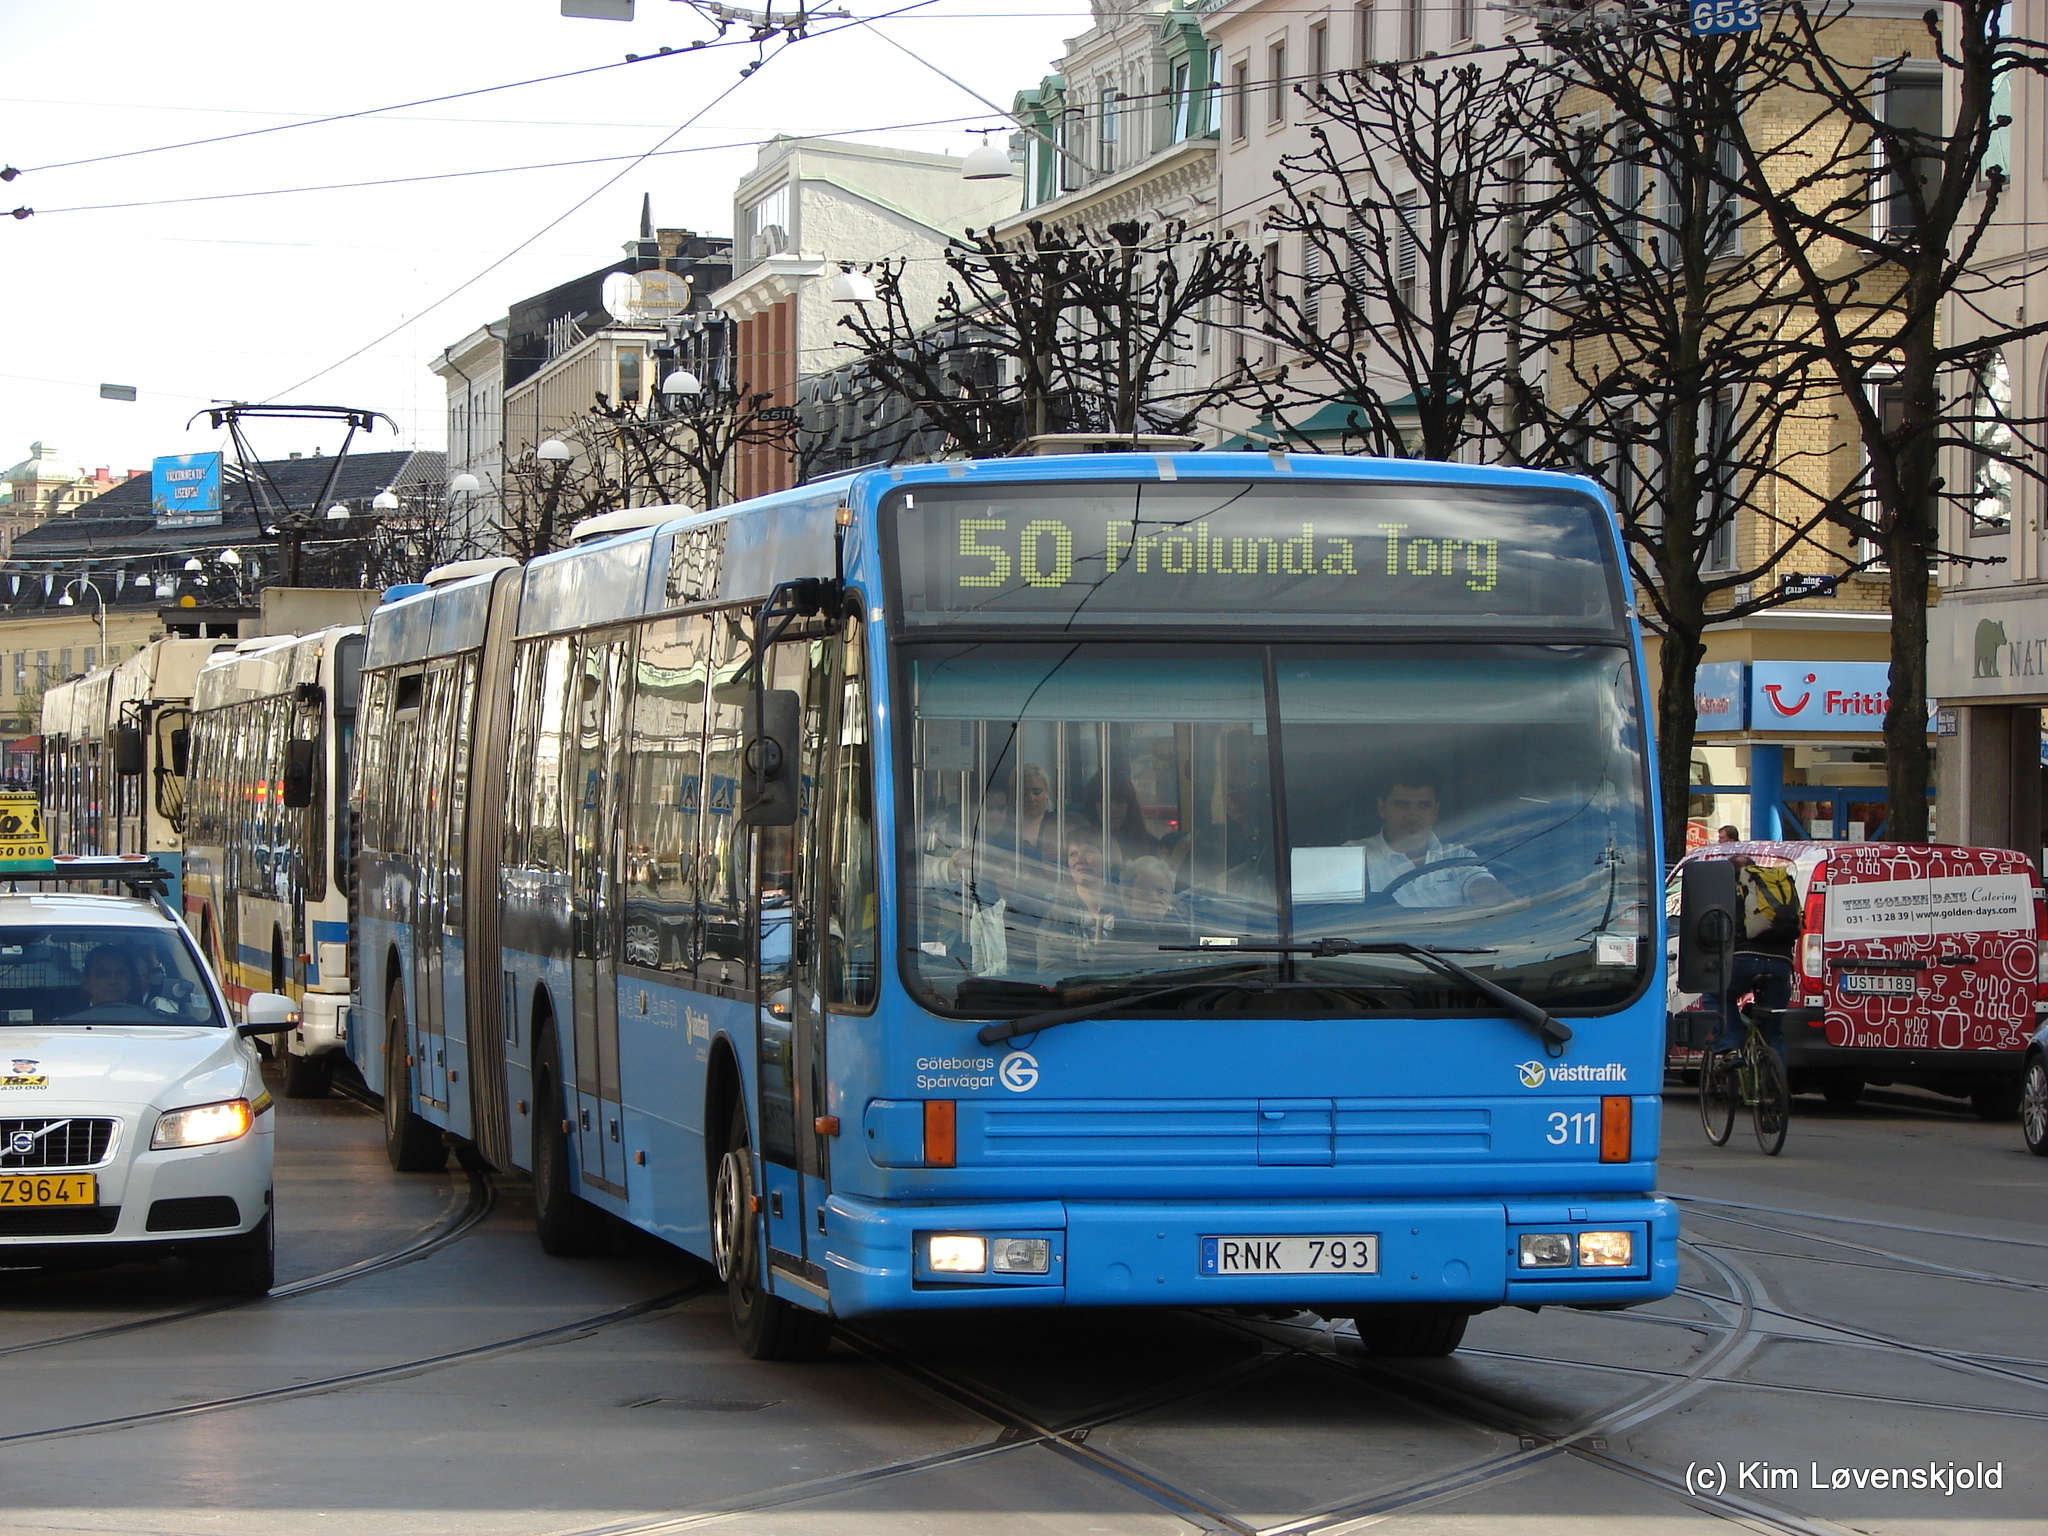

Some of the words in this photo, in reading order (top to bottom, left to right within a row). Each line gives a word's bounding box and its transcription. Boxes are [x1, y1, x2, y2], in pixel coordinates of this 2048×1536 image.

[1693, 0, 1758, 30] 653
[760, 410, 791, 421] 6511
[958, 519, 1072, 588] 50
[1106, 520, 1358, 575] Frölunda
[1378, 522, 1498, 592] Torg
[2009, 638, 2047, 677] NAT
[1843, 898, 1872, 911] THE
[1874, 894, 1929, 908] GOLDEN
[1932, 892, 1967, 904] DAYS
[1971, 886, 2017, 904] Catering
[1846, 915, 1863, 924] 031
[1871, 914, 1882, 922] 13
[1884, 912, 1896, 921] 28
[1897, 911, 1909, 920] 39
[1915, 907, 2017, 919] www.golden-days.com
[1849, 976, 1875, 989] UST
[1888, 977, 1912, 990] 189
[916, 1057, 994, 1071] Göteborgs
[1548, 1063, 1627, 1081] västtrafik
[916, 1073, 994, 1090] Spårvägar
[1546, 1111, 1596, 1145] 311
[0, 1179, 70, 1203] Z964
[76, 1182, 87, 1198] T
[1223, 1241, 1282, 1270] RNK
[1308, 1241, 1369, 1269] 793
